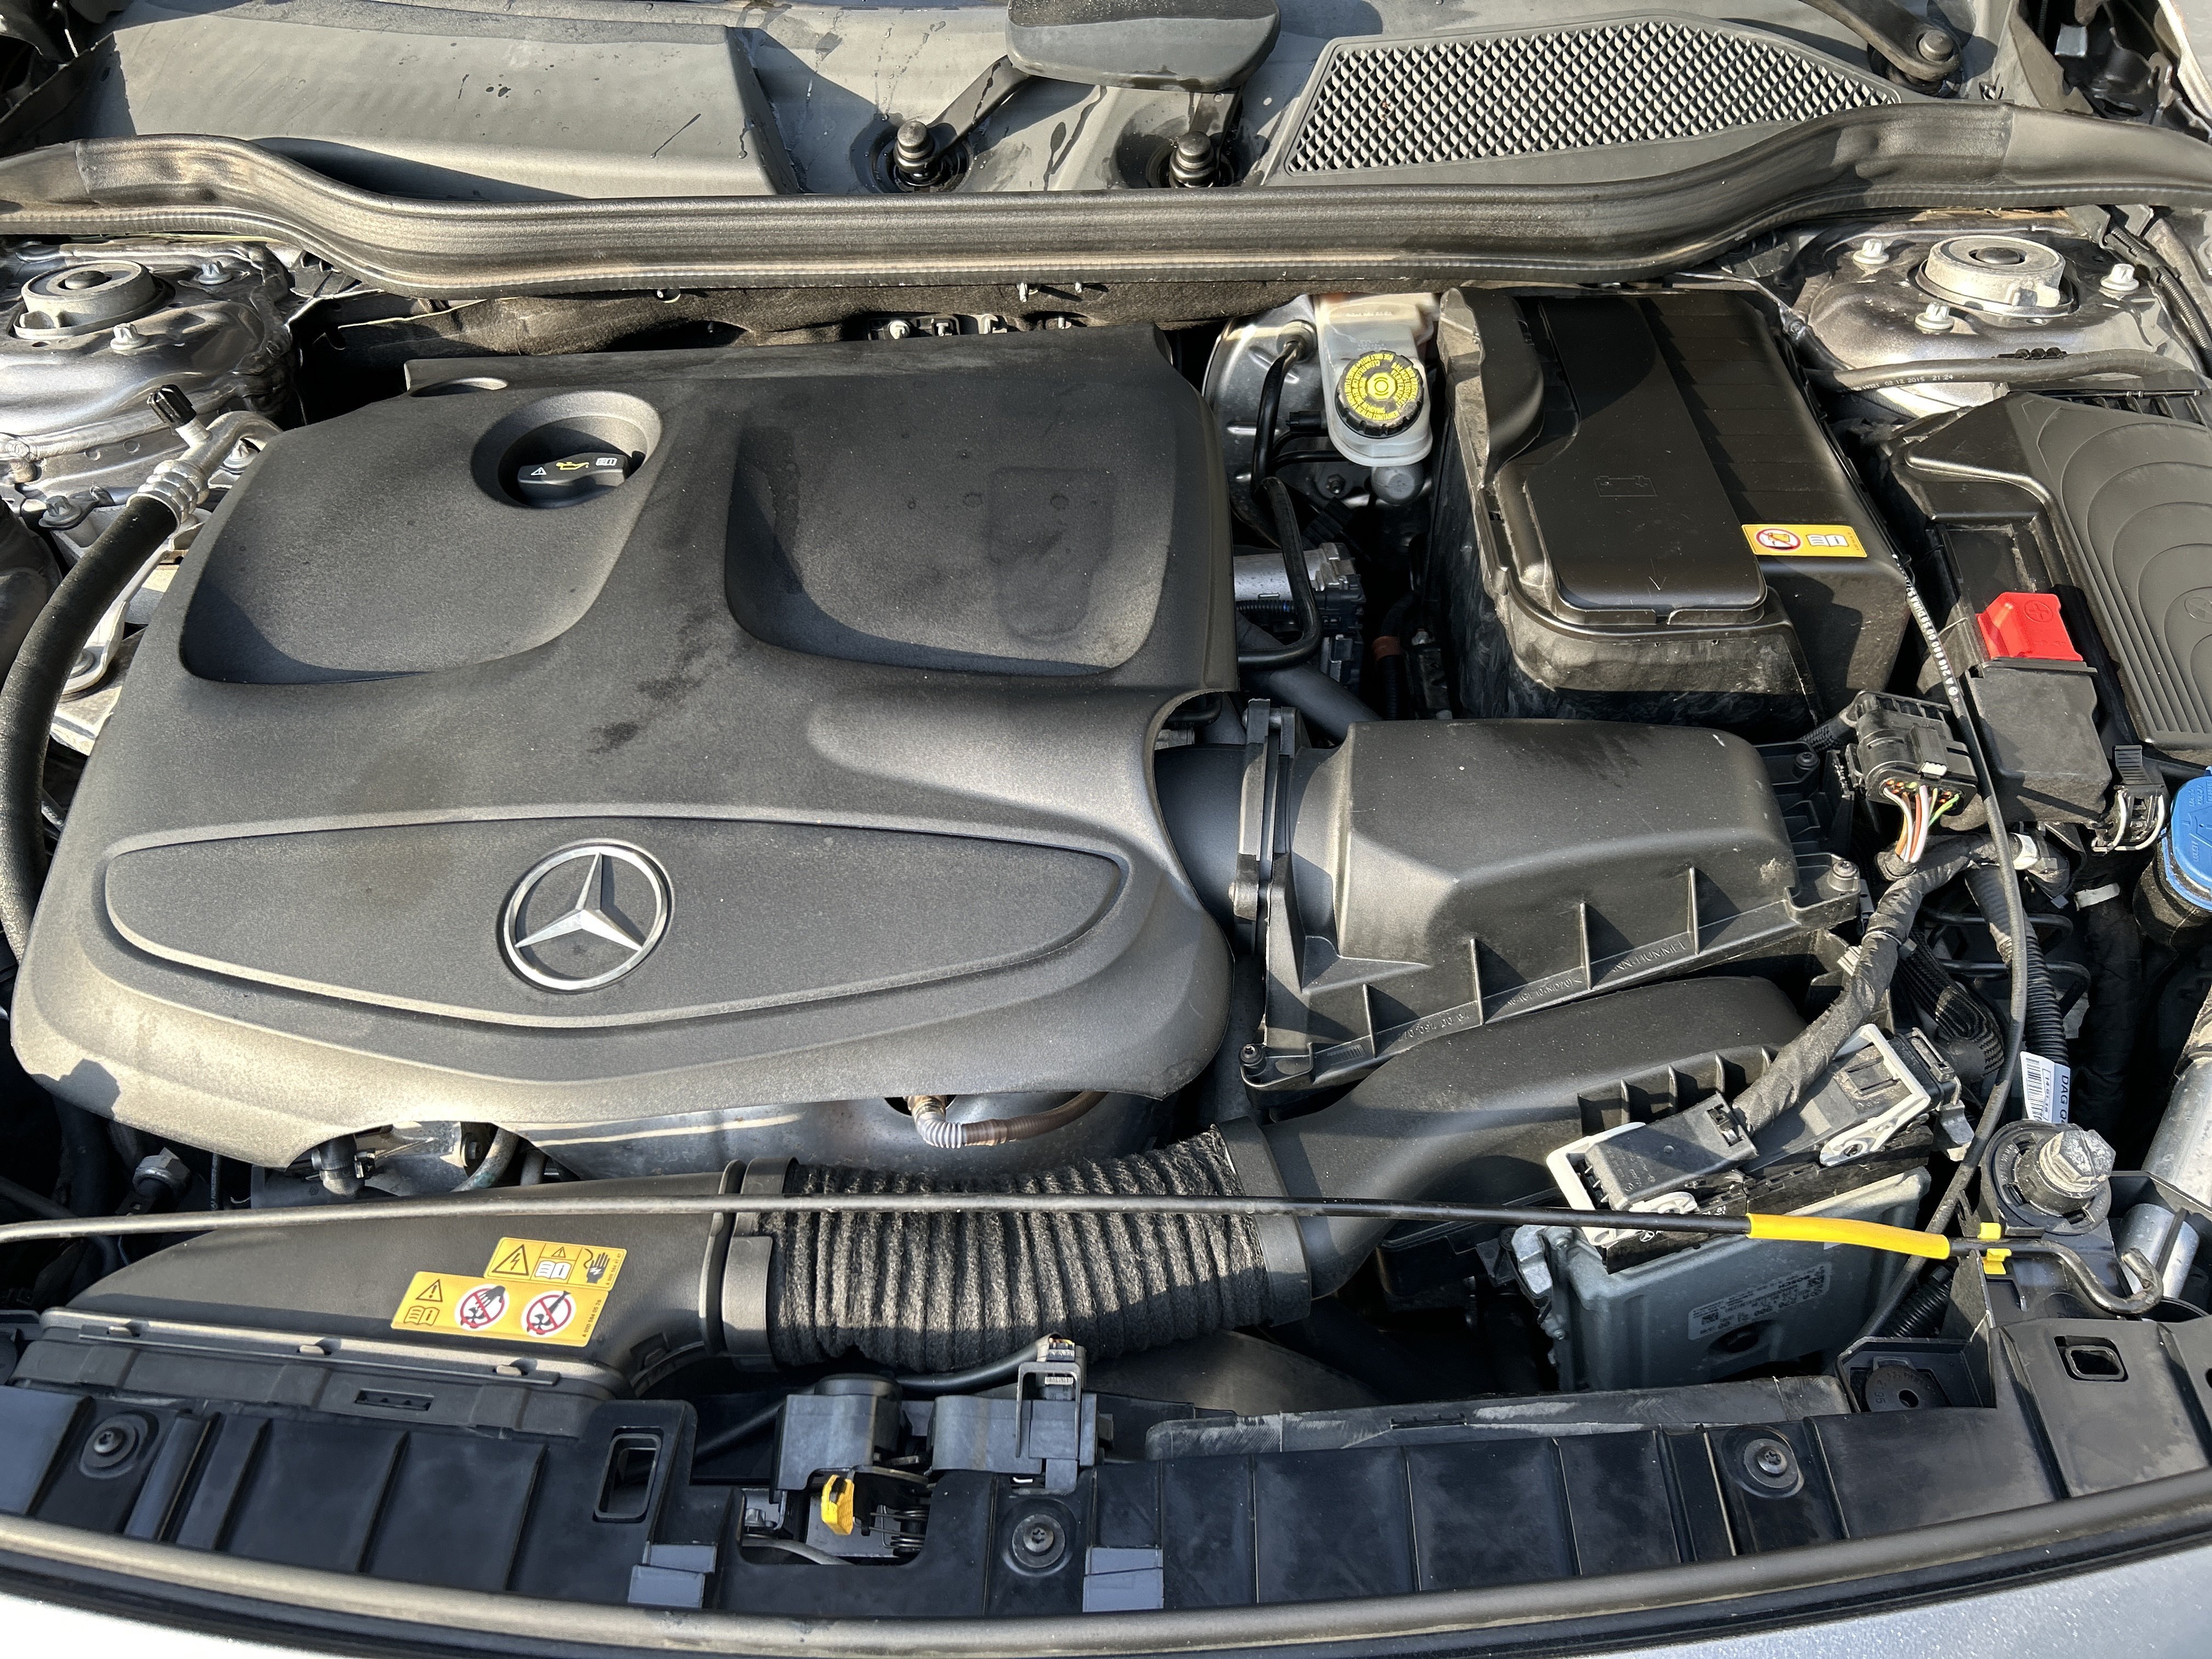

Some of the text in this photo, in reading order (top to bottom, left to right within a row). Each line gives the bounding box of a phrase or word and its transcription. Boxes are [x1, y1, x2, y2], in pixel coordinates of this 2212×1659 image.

[1372, 411, 1399, 421] CONTAINER
[1910, 596, 1926, 618] DURA
[2060, 1075, 2069, 1105] DAG
